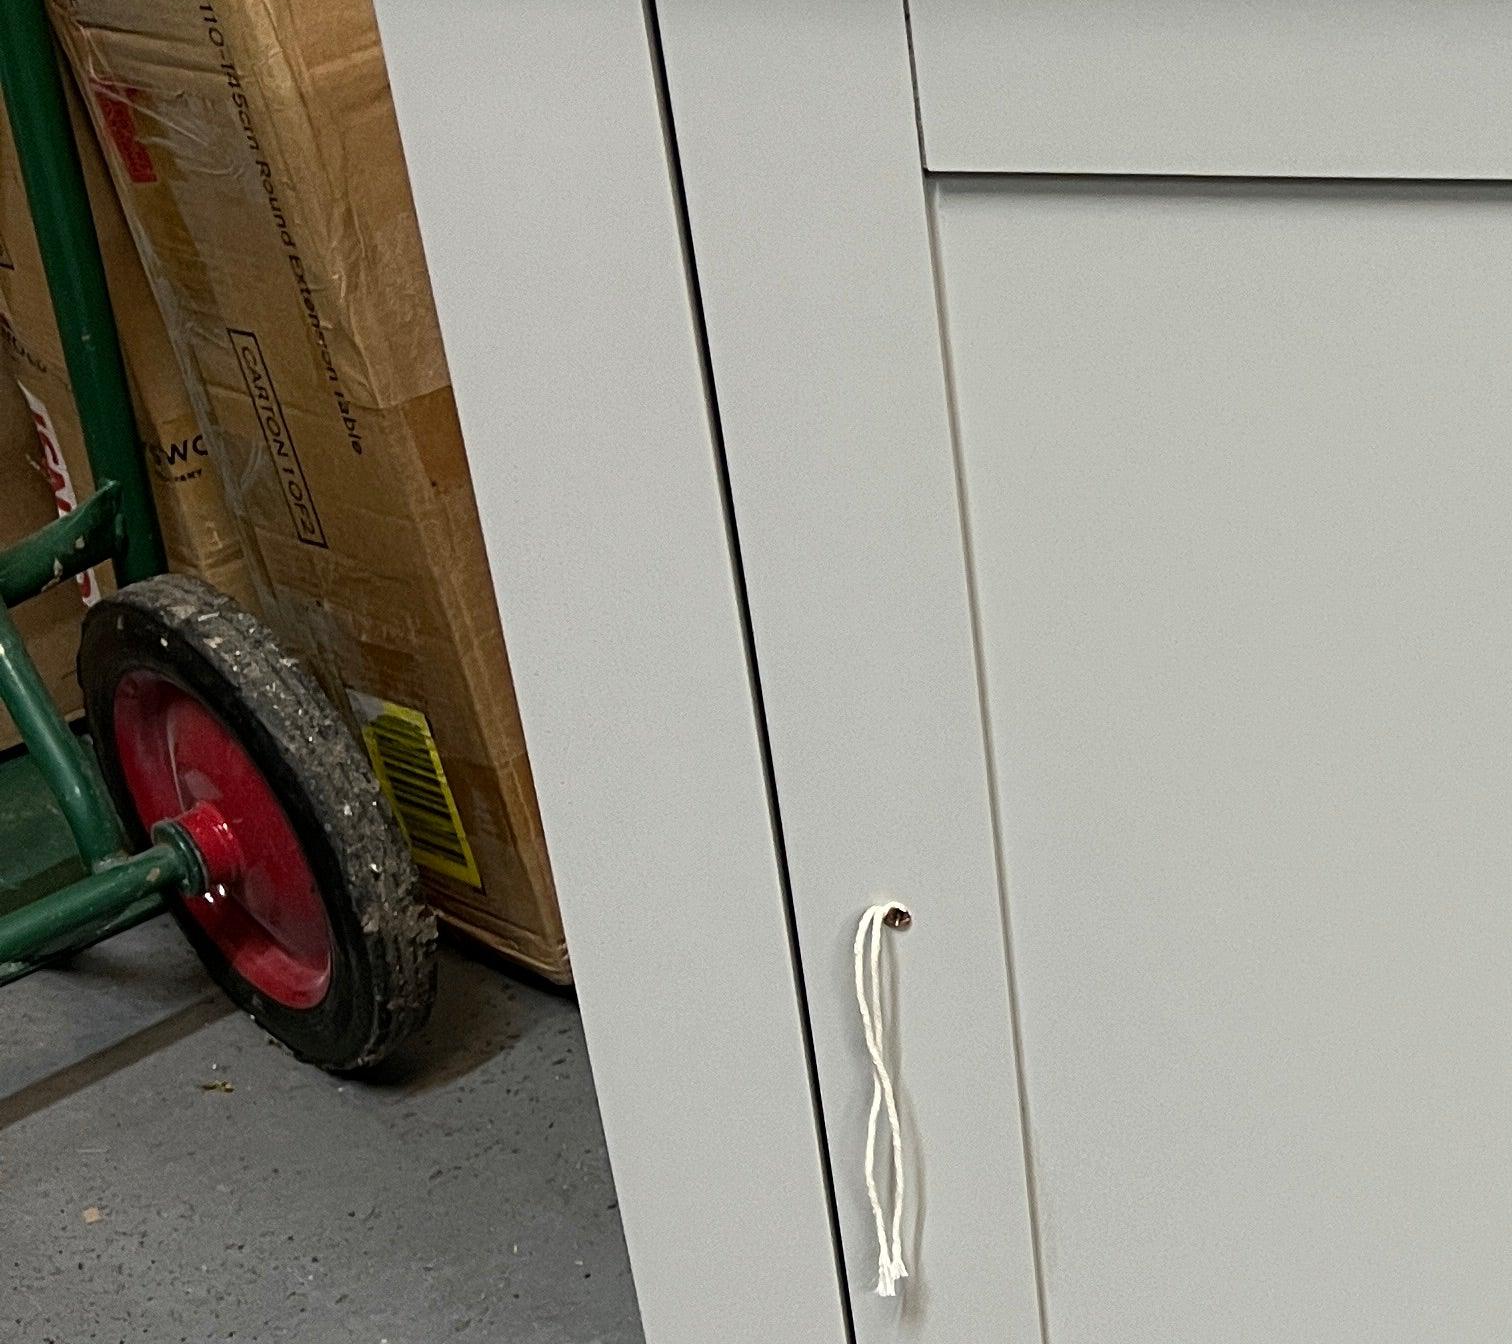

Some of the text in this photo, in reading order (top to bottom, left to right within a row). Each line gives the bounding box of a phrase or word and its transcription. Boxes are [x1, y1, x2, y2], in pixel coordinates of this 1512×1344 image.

[240, 344, 290, 459] CARTON
[255, 159, 297, 249] Round
[288, 254, 339, 382] Extension
[333, 390, 364, 456] Table
